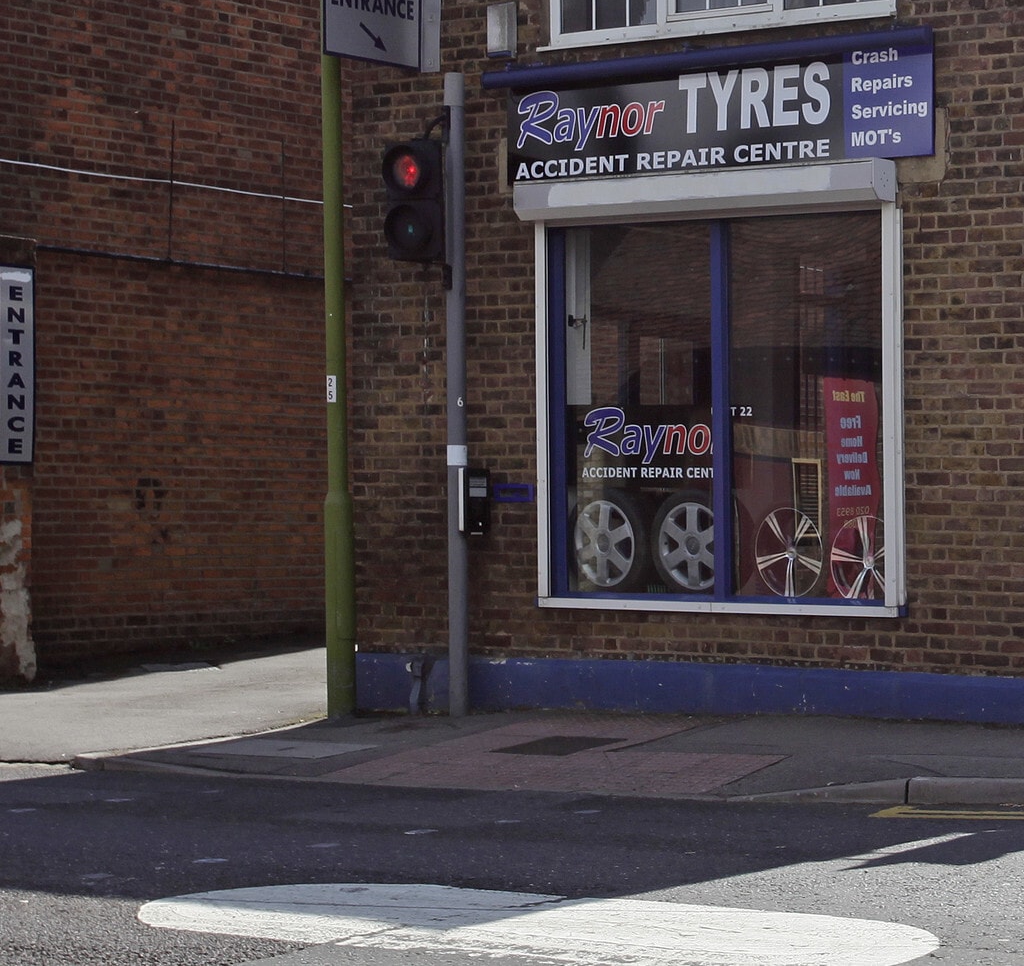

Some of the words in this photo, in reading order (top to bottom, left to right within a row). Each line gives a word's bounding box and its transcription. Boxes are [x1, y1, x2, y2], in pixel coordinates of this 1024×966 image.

[851, 47, 898, 66] Crash
[851, 74, 913, 94] Repairs
[516, 90, 666, 151] Raynor
[678, 61, 832, 134] TYRES
[851, 100, 928, 121] Servicing
[851, 128, 902, 148] MOT's
[515, 154, 630, 180] ACCIDENT
[636, 146, 726, 172] REPAIR
[733, 139, 831, 163] CENTRE
[7, 286, 25, 454] ENTRANCE
[740, 406, 753, 417] 22
[584, 407, 713, 464] Rayno
[582, 467, 637, 479] ACCIDENT
[641, 467, 683, 479] REPAIR
[687, 467, 713, 479] CENT
